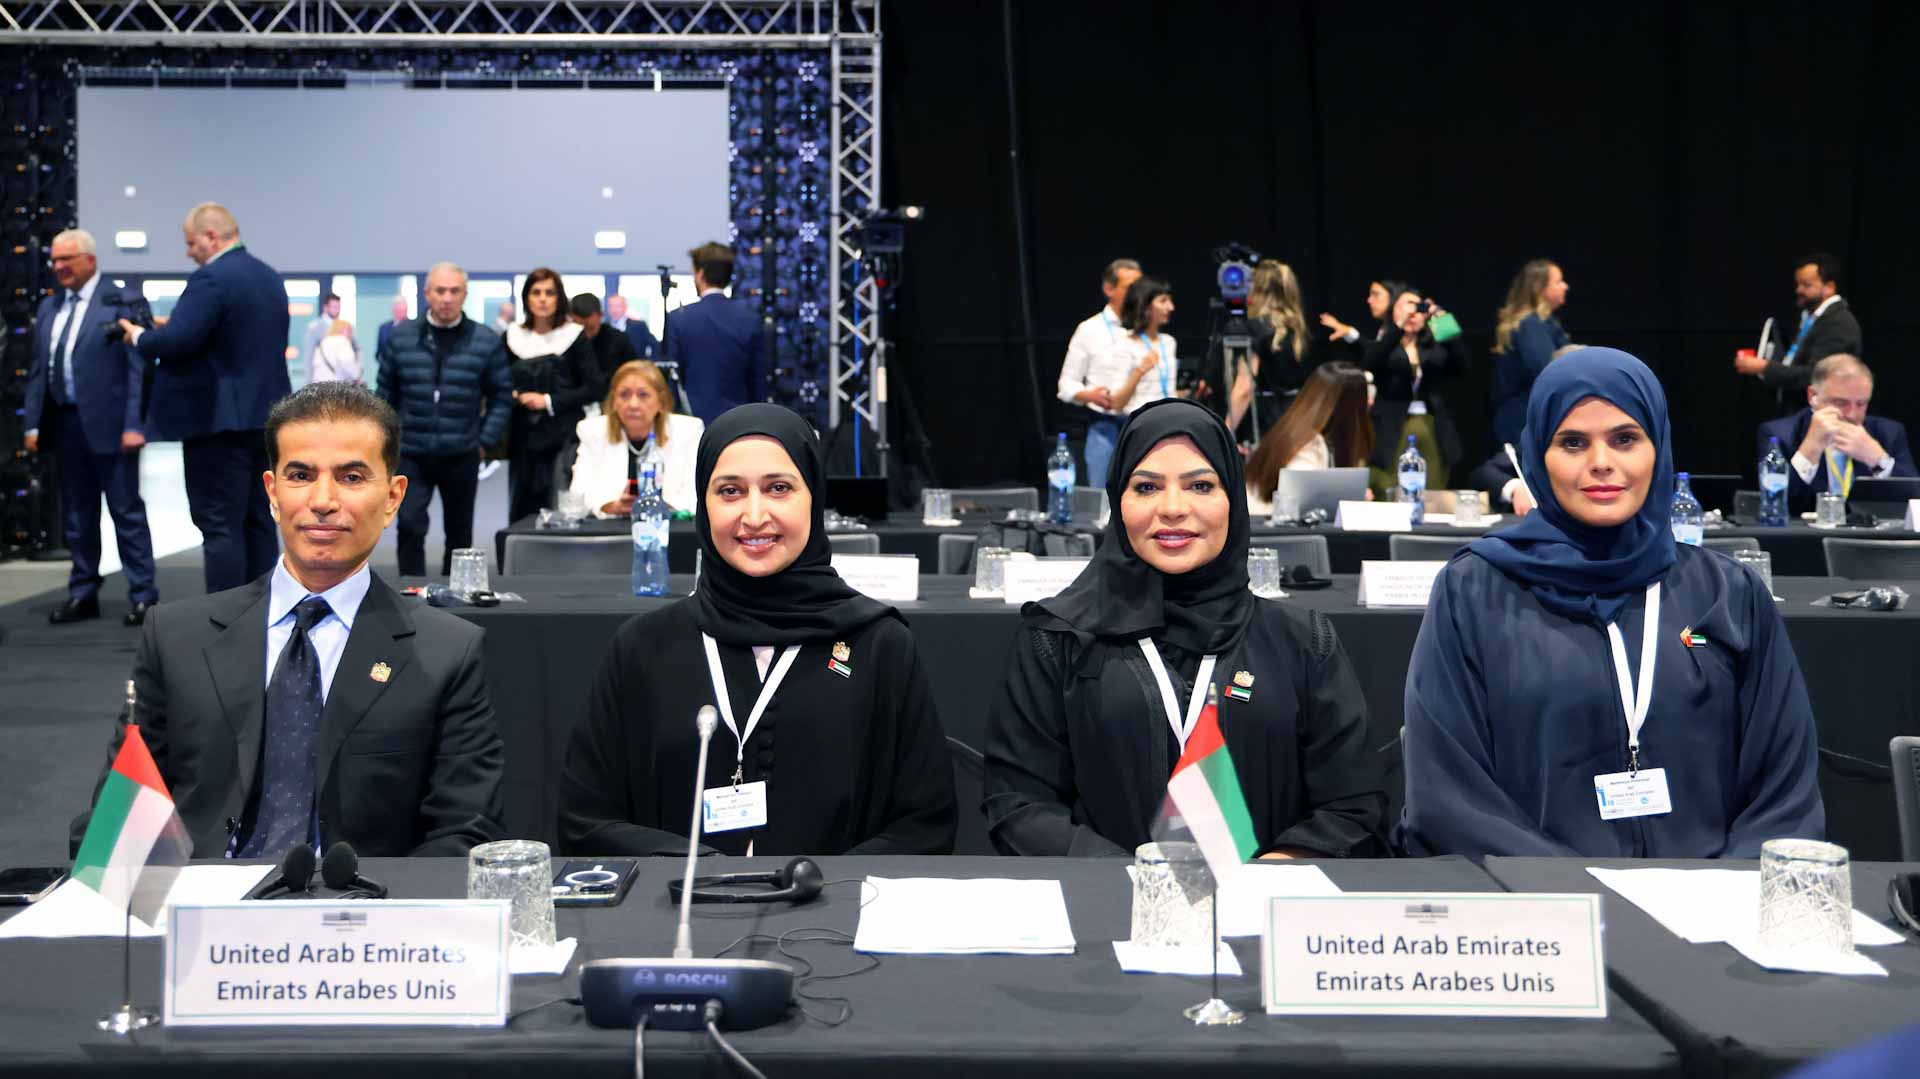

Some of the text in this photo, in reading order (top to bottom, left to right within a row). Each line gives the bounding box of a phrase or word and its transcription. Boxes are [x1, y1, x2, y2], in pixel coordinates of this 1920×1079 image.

[211, 943, 466, 964] United Arab Emirates
[1307, 936, 1560, 955] United Arab Emirates
[218, 979, 455, 1000] Emirats Arabes Unis
[664, 973, 727, 986] BOSCH
[1317, 972, 1554, 992] Emirats Arabes Unis
